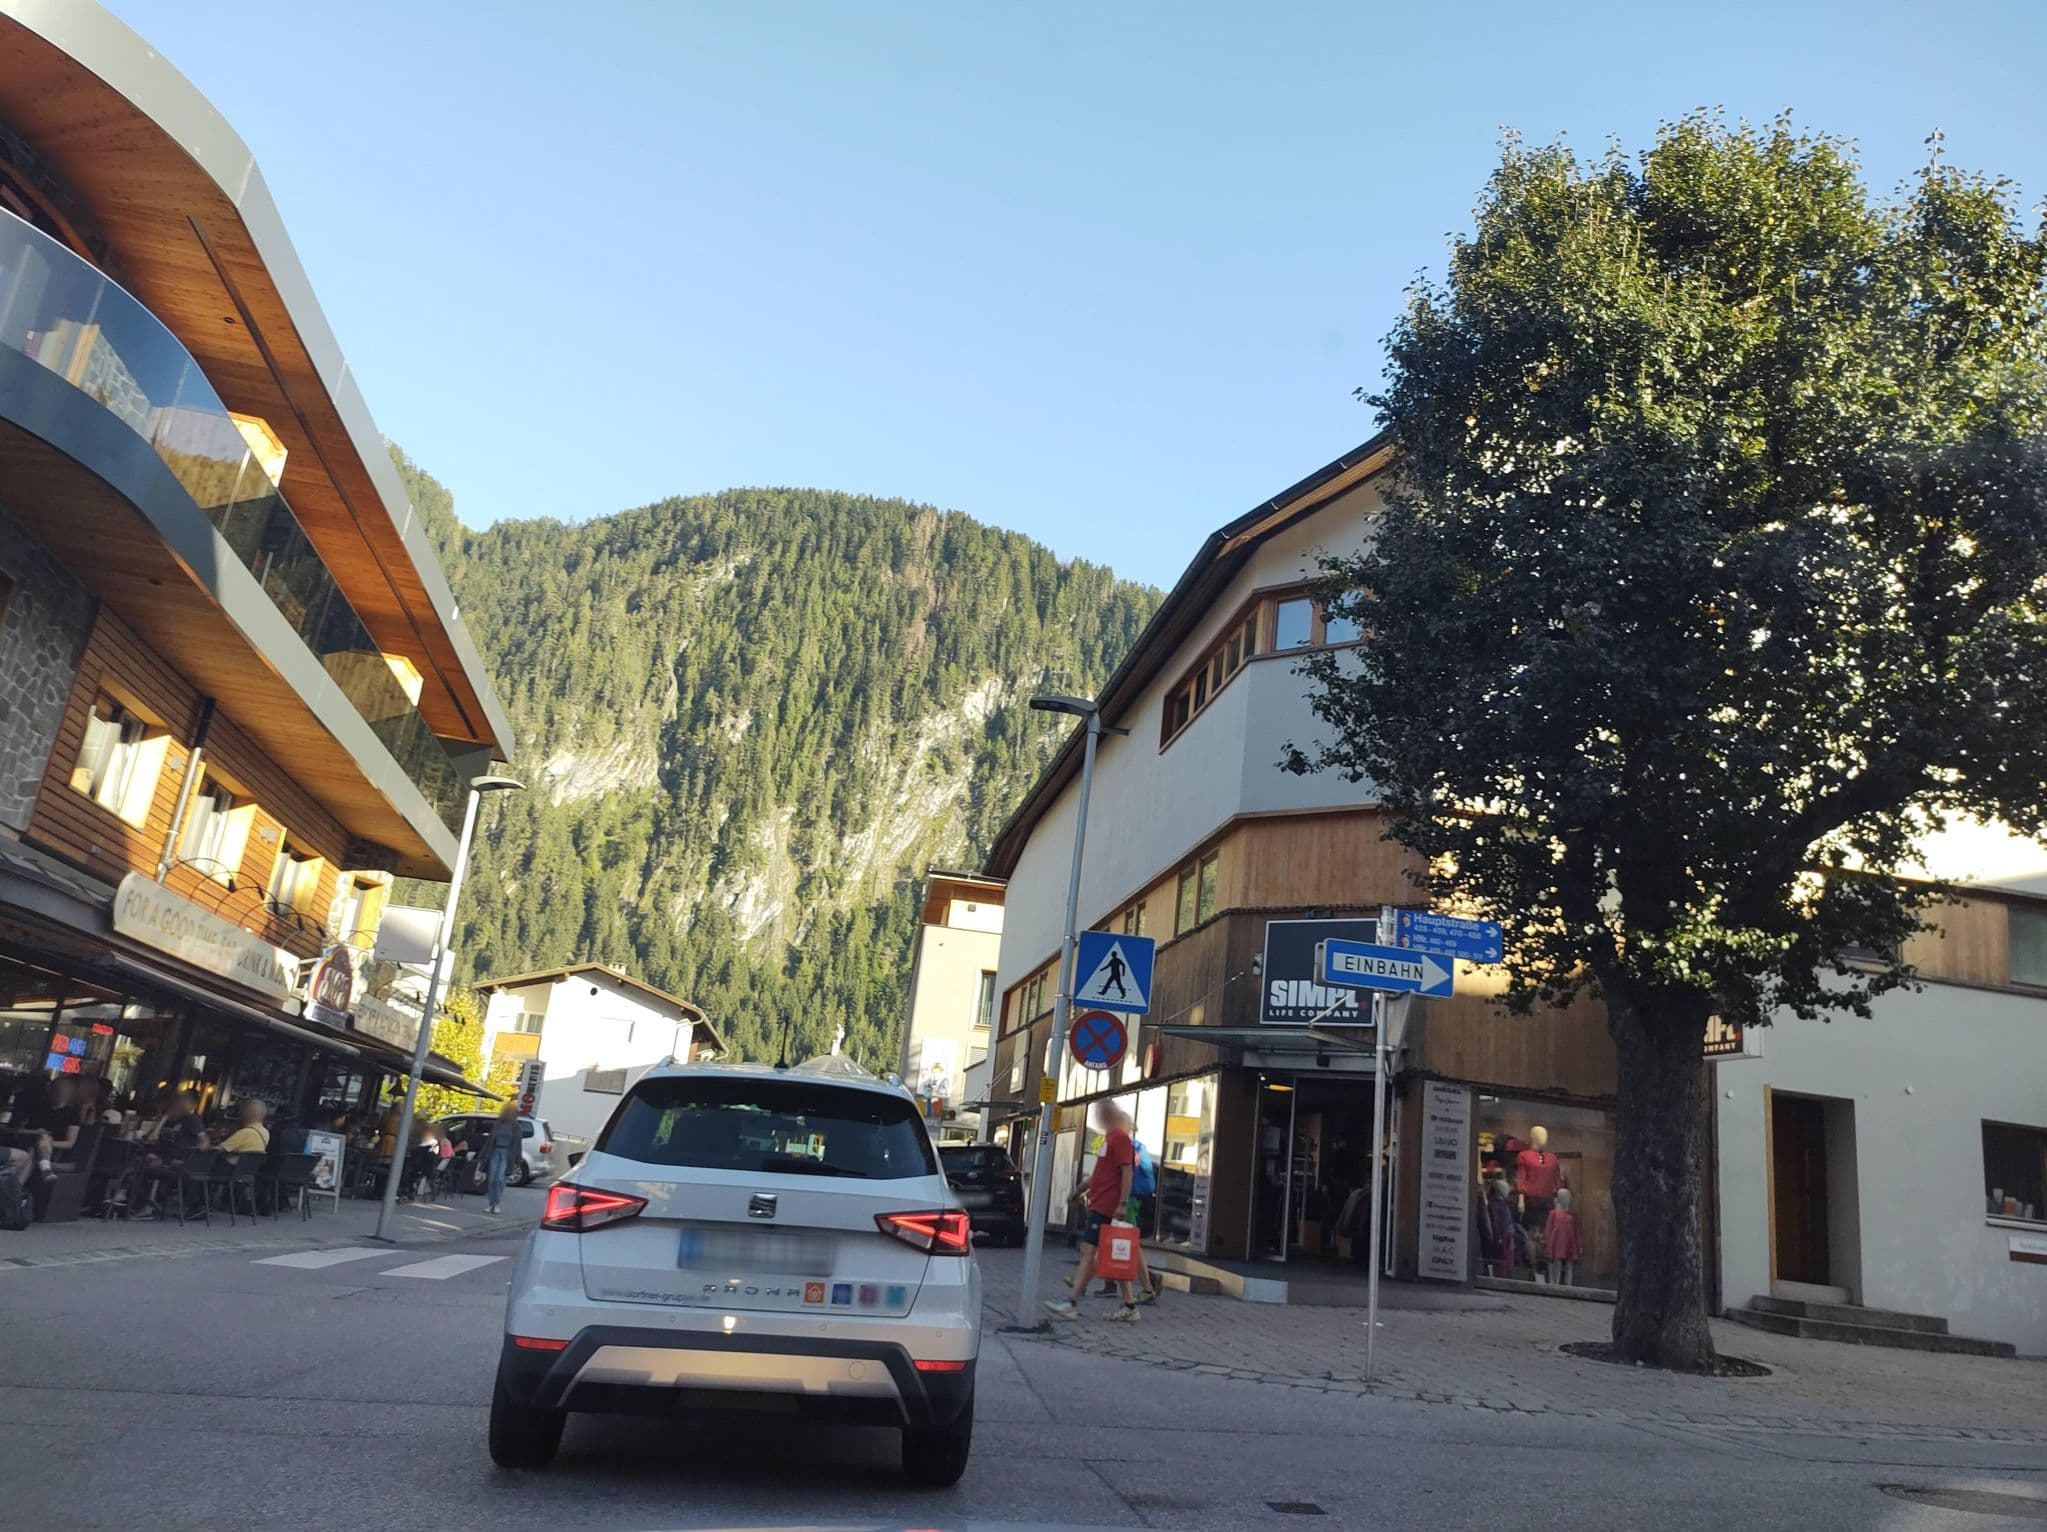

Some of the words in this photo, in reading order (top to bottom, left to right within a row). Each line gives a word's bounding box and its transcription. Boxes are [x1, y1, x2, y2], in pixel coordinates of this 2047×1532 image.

[1413, 912, 1480, 931] Hauptstraße
[1345, 956, 1424, 980] EINBAHN
[1269, 1009, 1294, 1017] LIFE
